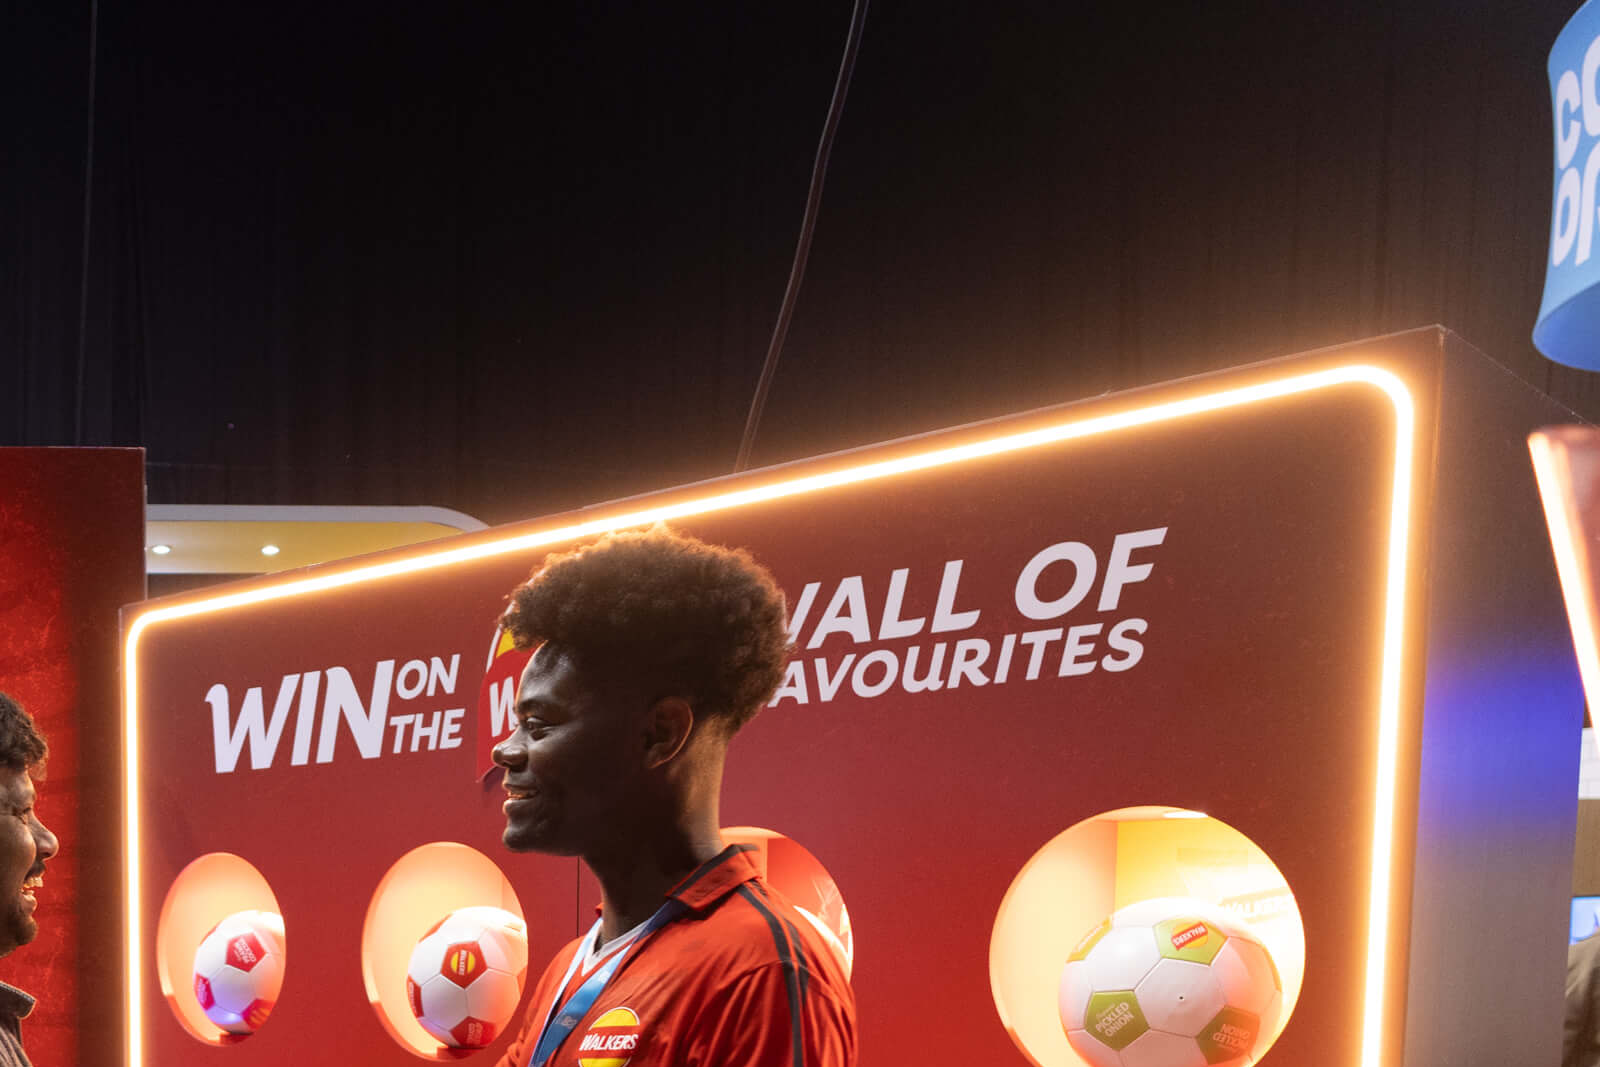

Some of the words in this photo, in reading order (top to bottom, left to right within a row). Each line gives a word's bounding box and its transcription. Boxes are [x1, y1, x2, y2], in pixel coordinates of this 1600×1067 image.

[1015, 527, 1169, 620] OF
[768, 619, 1148, 708] AVOURITES
[205, 660, 395, 774] WIN
[396, 654, 461, 700] ON
[390, 709, 466, 754] THE
[1095, 1002, 1130, 1033] PICKLED
[1105, 1012, 1134, 1037] ONION
[578, 1034, 640, 1051] WALKERS
